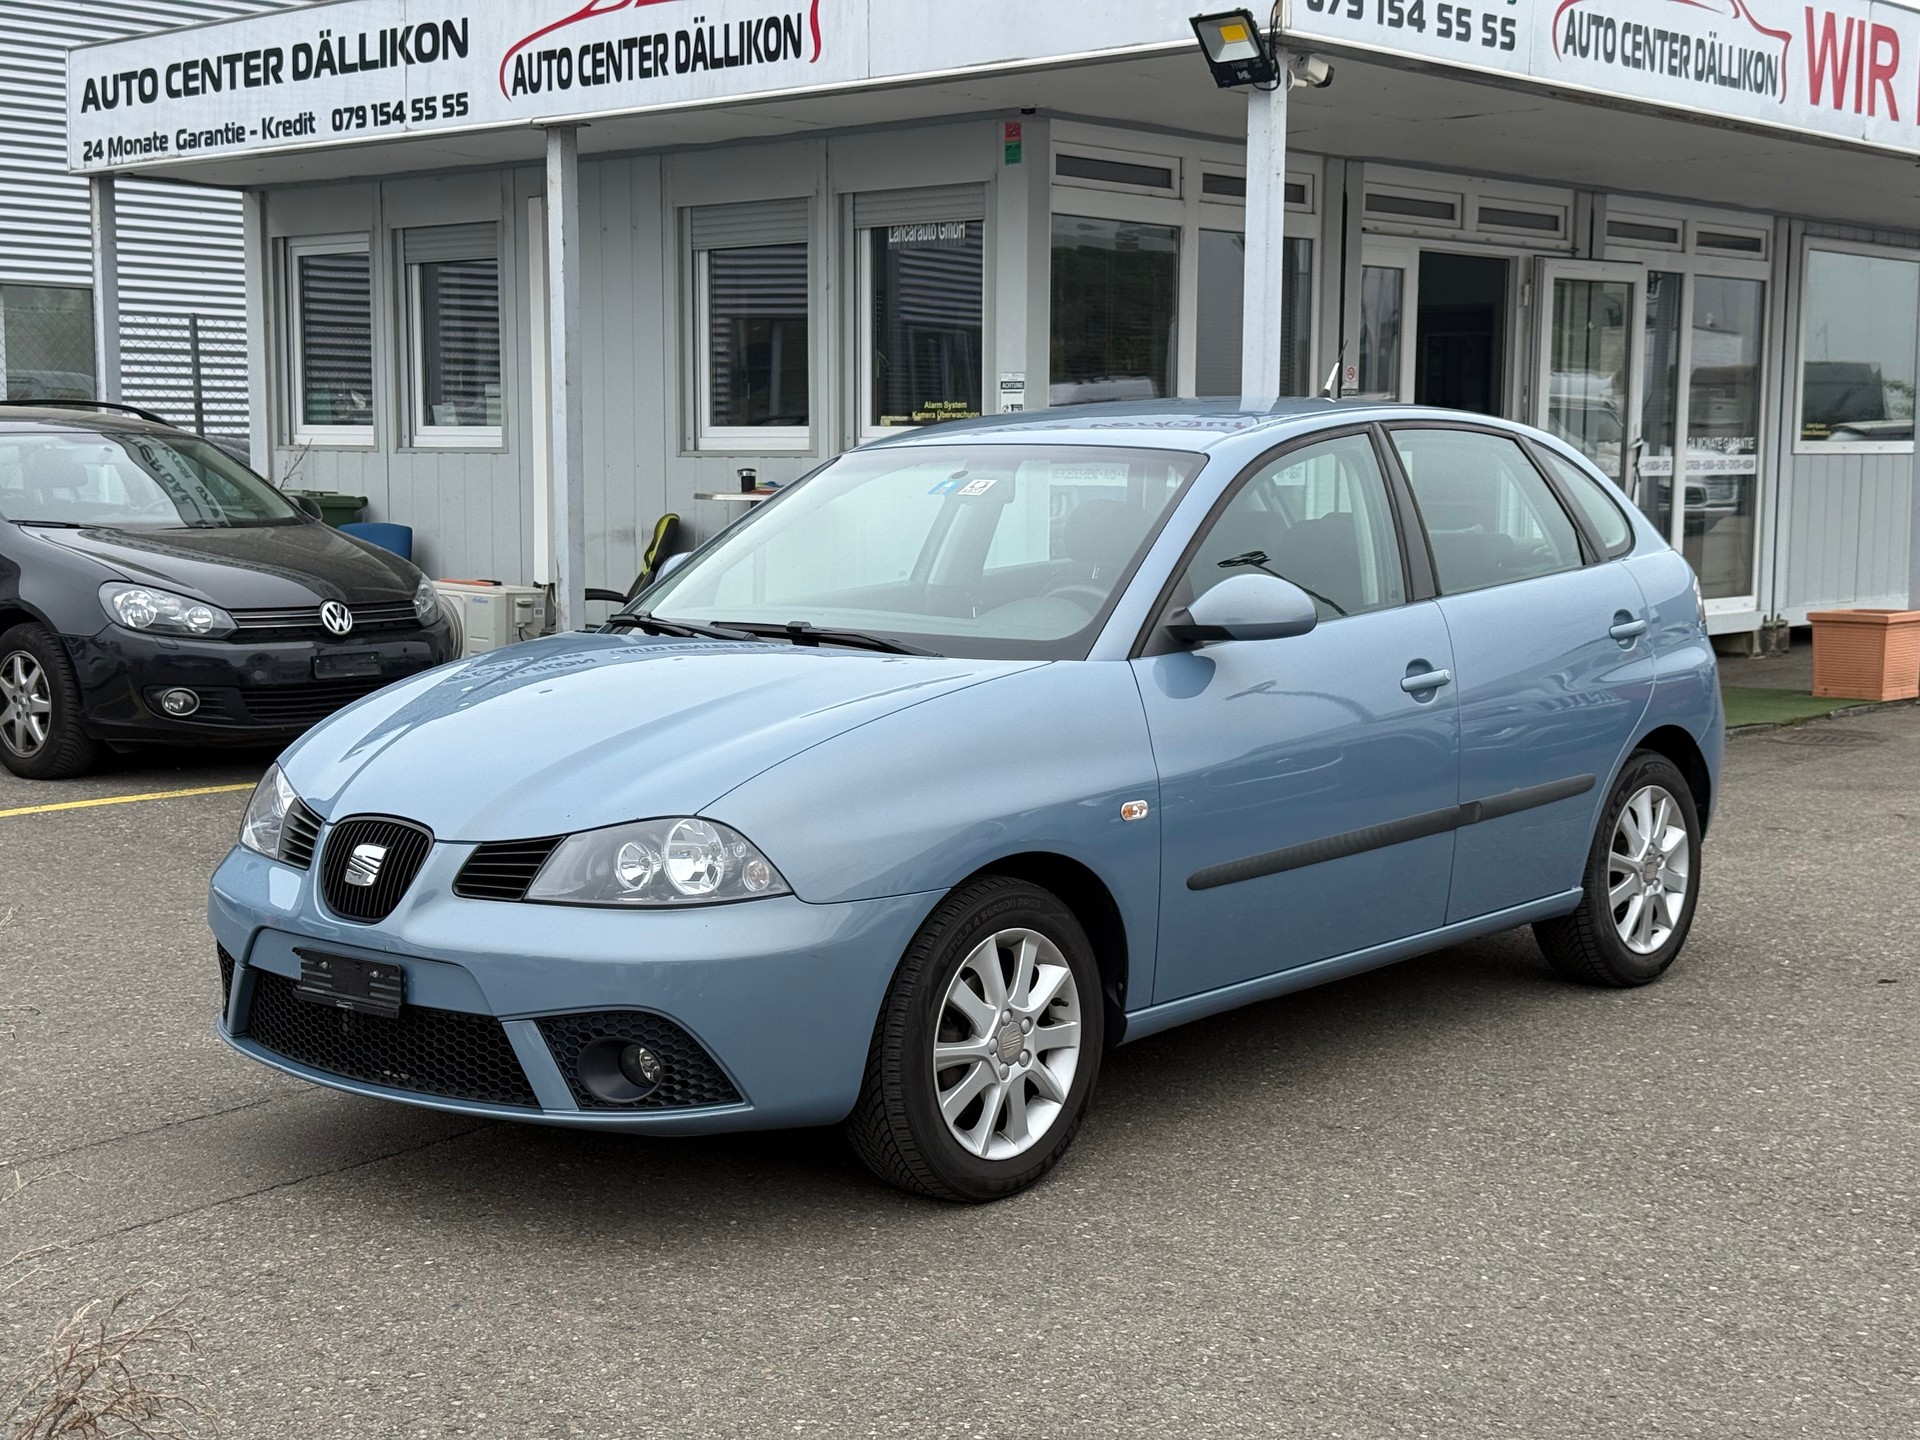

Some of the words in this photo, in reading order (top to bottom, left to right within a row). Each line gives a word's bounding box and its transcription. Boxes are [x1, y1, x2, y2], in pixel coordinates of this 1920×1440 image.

[511, 47, 573, 96] AUTO
[578, 32, 669, 87] CENTER
[675, 12, 802, 74] DÄLLIKON
[1377, 0, 1426, 33] 154
[1437, 3, 1472, 42] 55
[1481, 13, 1516, 51] 55
[1562, 8, 1617, 64] AUTO
[1621, 21, 1690, 79] CENTER
[1695, 31, 1779, 97] DÄLLIKON
[81, 67, 159, 114] AUTO
[165, 47, 284, 99] CENTER
[292, 17, 468, 81] DÄLLIKON
[1804, 6, 1900, 122] WIR
[83, 138, 104, 161] 24
[109, 131, 169, 158] Monate
[175, 121, 246, 151] Garantie
[261, 111, 316, 140] Kredit
[331, 105, 367, 132] 079
[371, 100, 406, 127] 154
[411, 95, 437, 122] 55
[442, 92, 468, 118] 55
[912, 411, 936, 419] Kamera
[924, 401, 942, 409] Alarm
[943, 401, 968, 410] System
